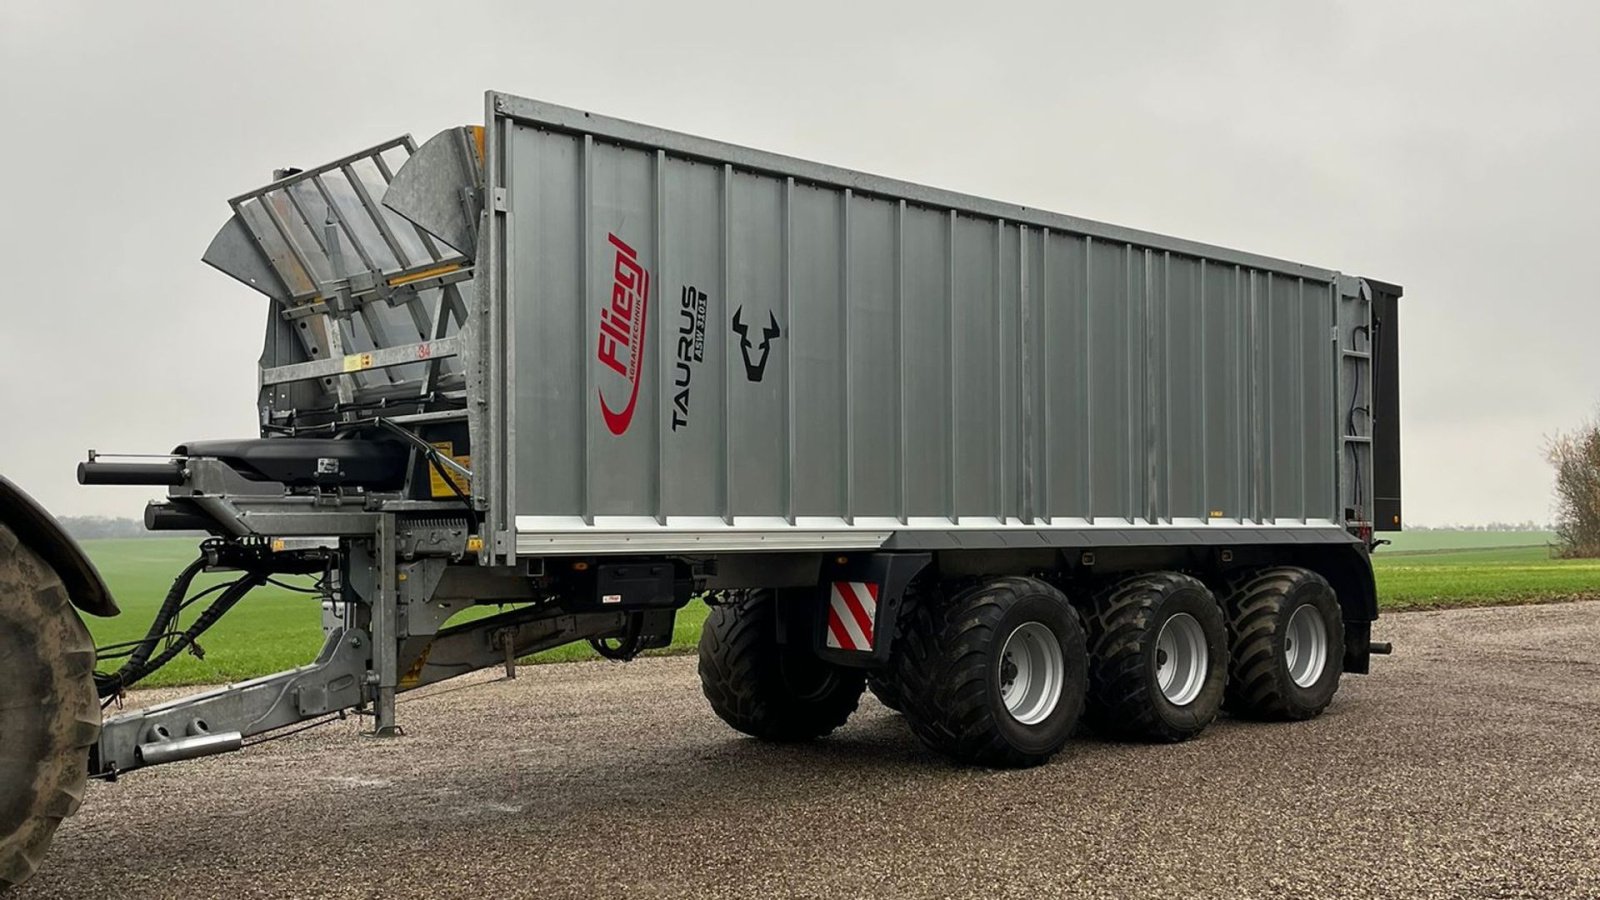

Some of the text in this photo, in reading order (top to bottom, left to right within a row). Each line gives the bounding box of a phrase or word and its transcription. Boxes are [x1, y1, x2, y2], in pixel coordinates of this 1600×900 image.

[598, 232, 643, 376] Fliegl
[628, 298, 641, 383] AGRARTECHNIK
[672, 285, 696, 432] TAURUS
[694, 299, 707, 359] ASW 3101
